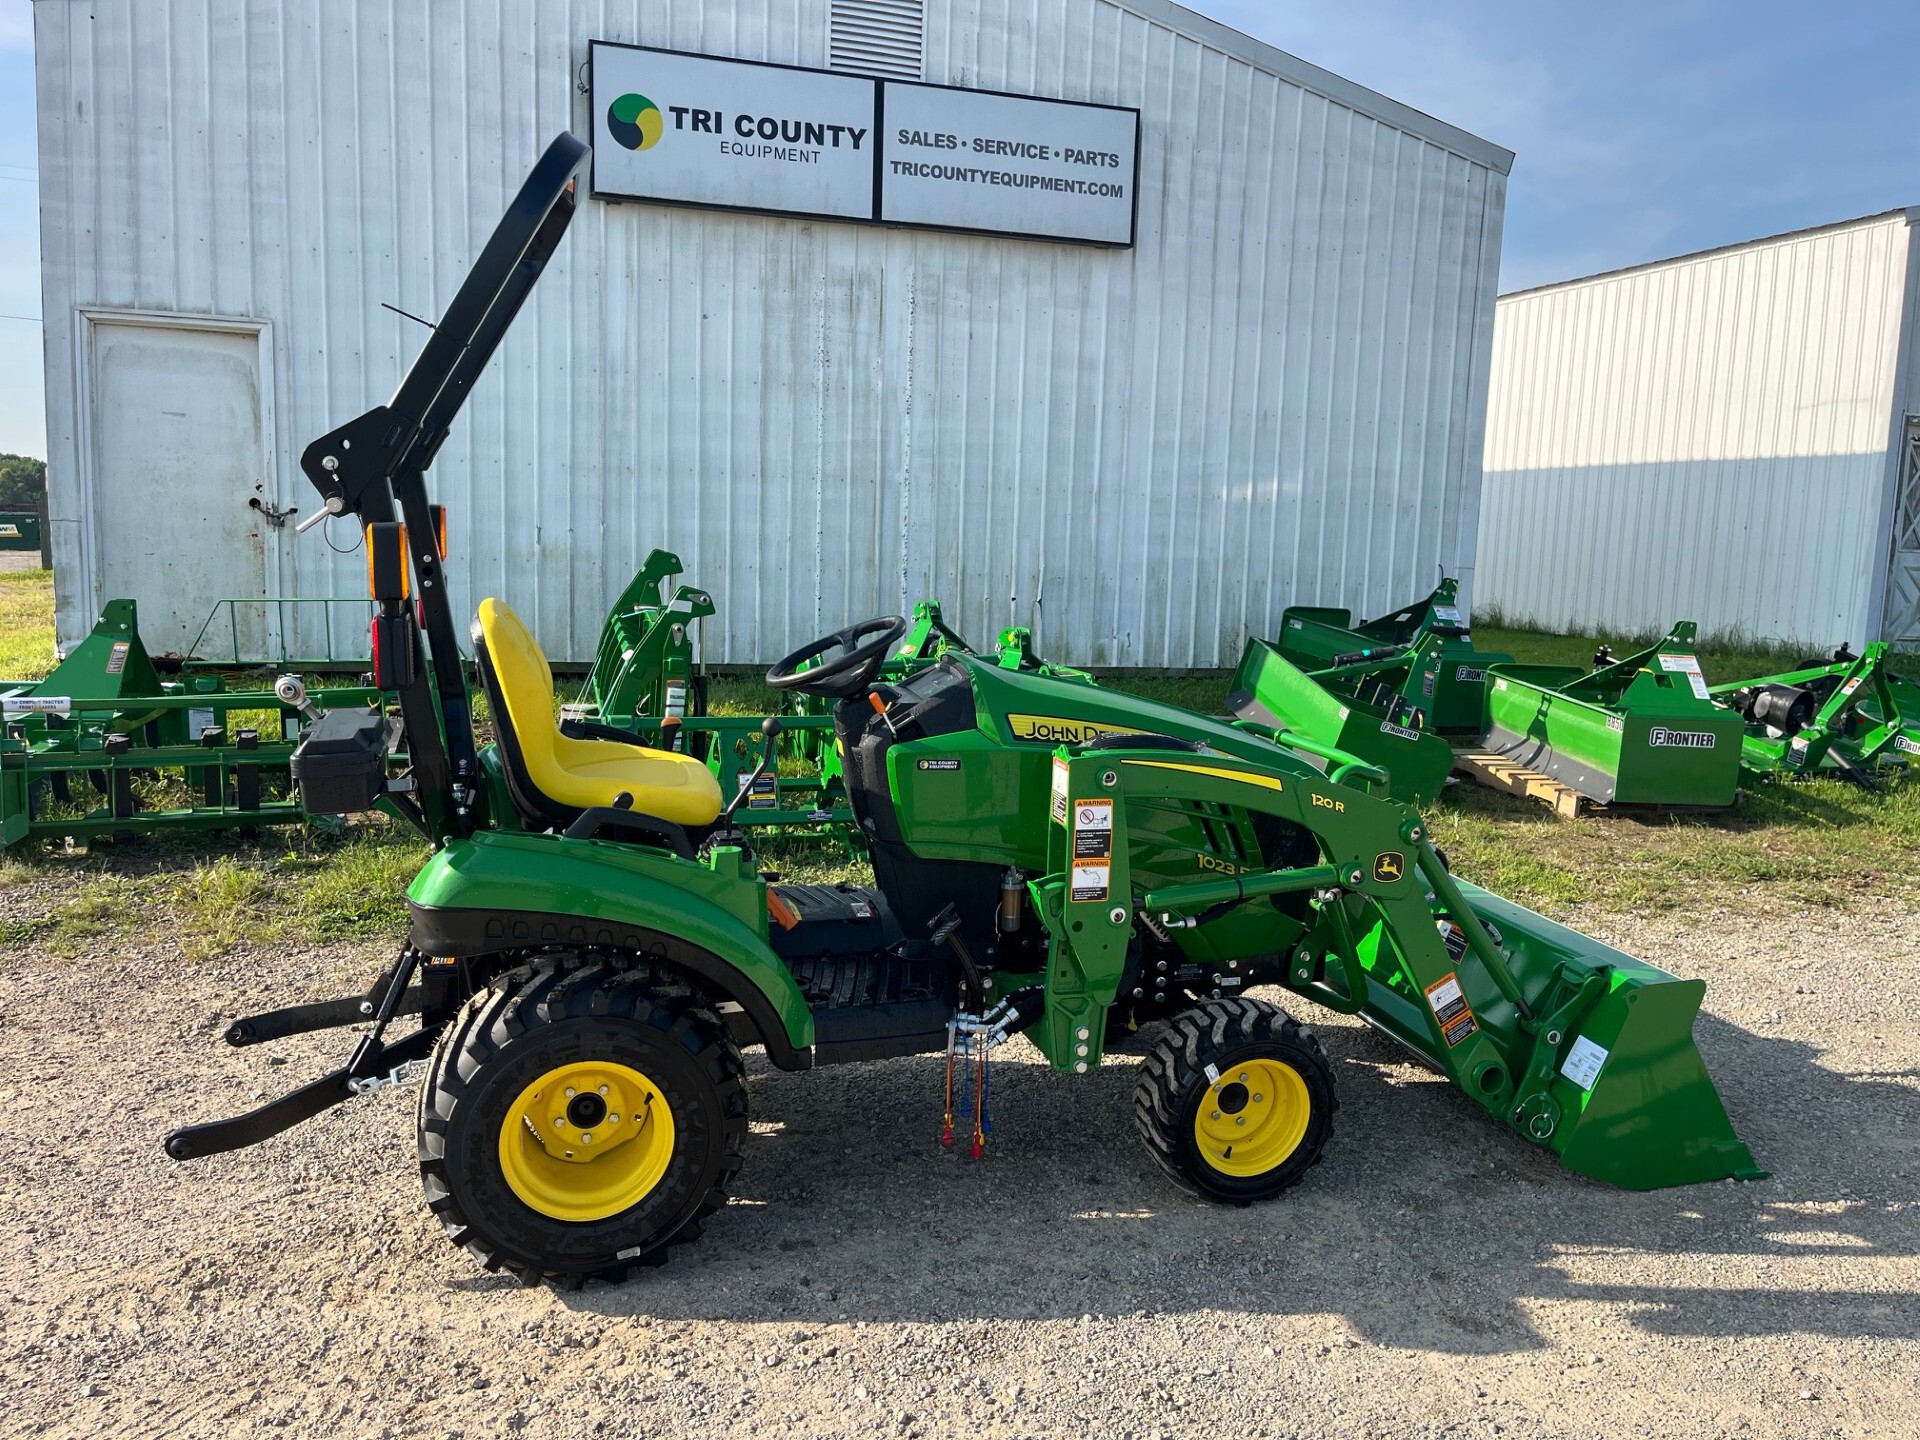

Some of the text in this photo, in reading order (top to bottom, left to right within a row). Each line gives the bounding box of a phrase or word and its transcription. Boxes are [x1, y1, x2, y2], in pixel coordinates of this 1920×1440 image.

[669, 106, 867, 150] TRI COUNTY
[720, 141, 821, 164] EQUIPMENT
[898, 129, 1119, 168] SALES SERVICE PARTS
[890, 160, 1123, 198] TRICOUNTYEQUIPMENT.COM
[1456, 667, 1487, 681] FRONT
[1026, 722, 1078, 740] JOHN
[1381, 722, 1418, 740] FRONTIER
[1651, 728, 1714, 747] FRONTIER
[1311, 793, 1344, 813] 120 R
[1197, 853, 1235, 875] 1023
